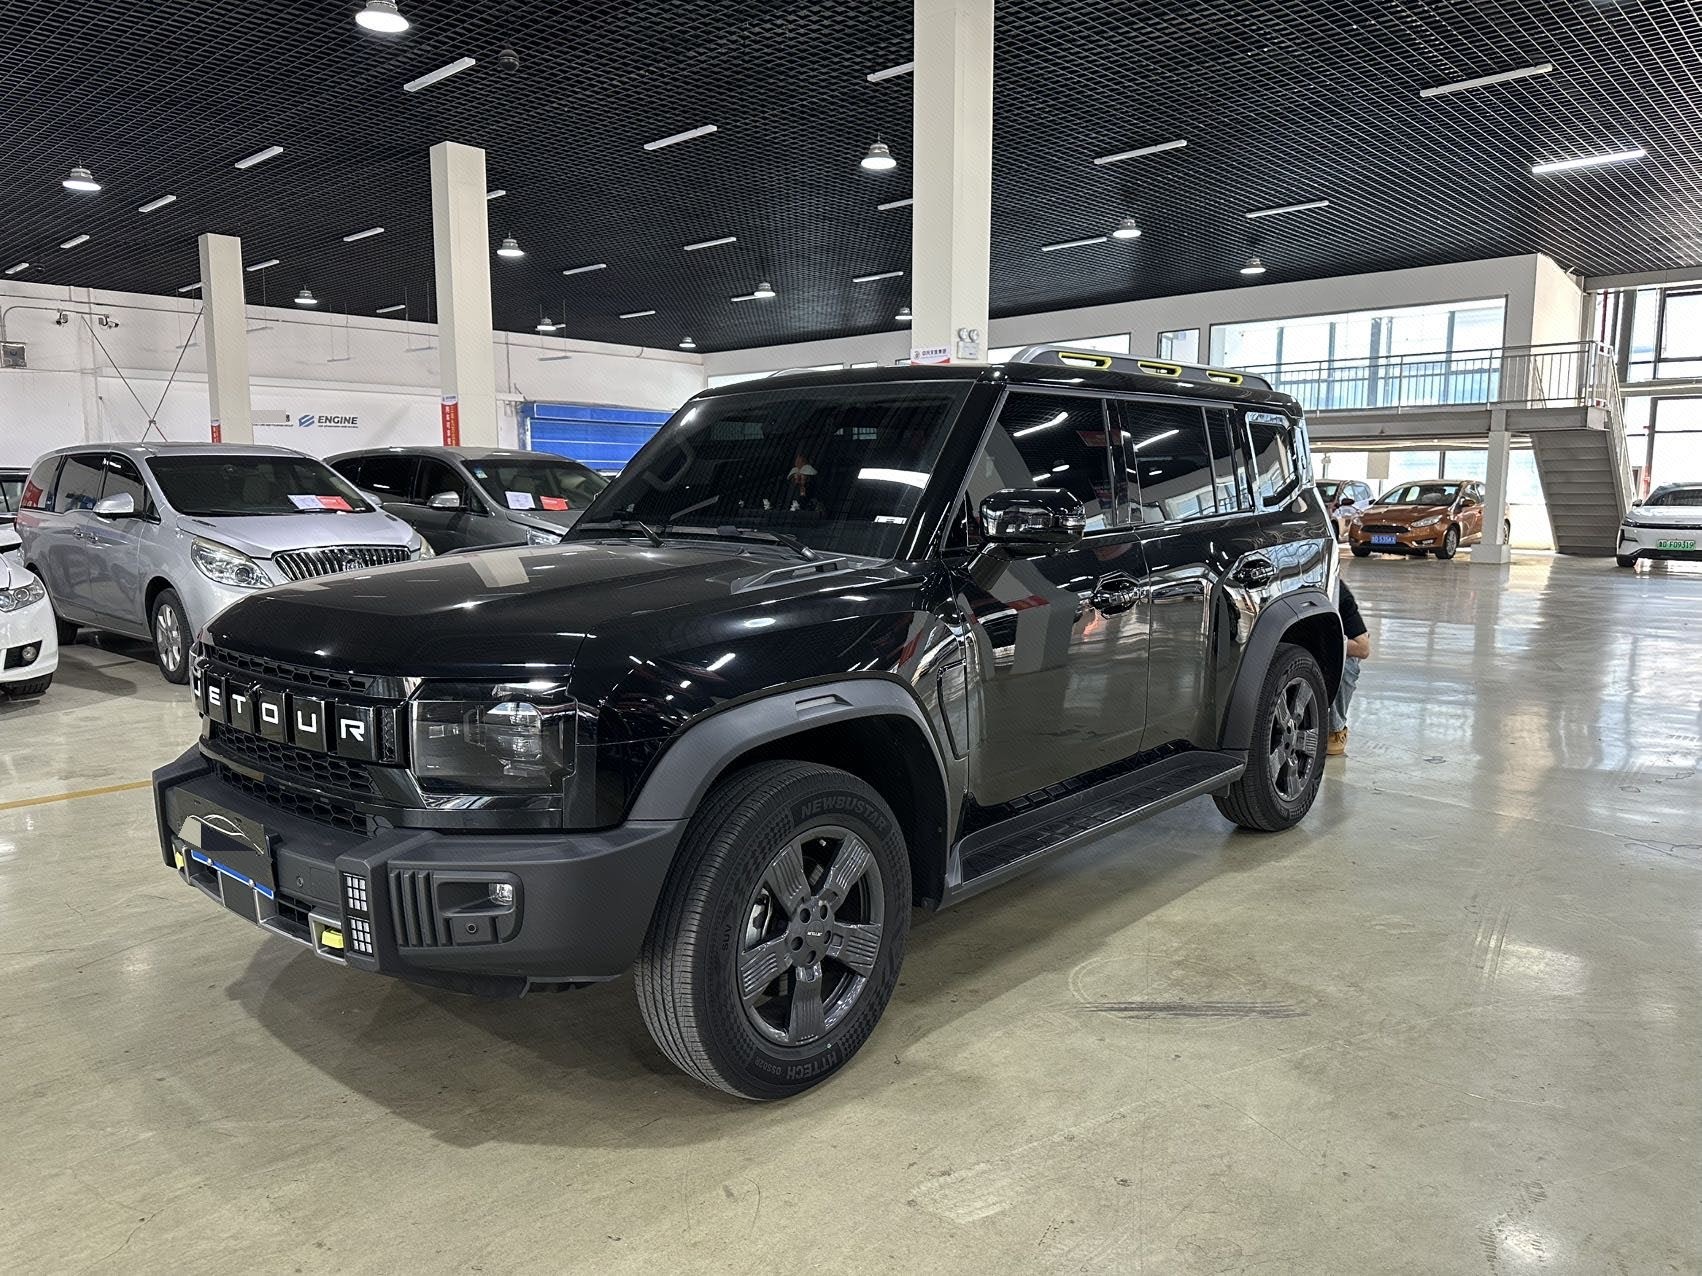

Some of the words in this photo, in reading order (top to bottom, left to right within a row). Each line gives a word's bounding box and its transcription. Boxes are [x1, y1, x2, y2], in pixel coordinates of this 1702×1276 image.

[318, 415, 359, 425] ENGINE
[194, 681, 365, 742] JETOUR
[801, 796, 887, 830] NEWBUSTAR
[722, 924, 732, 951] SUV
